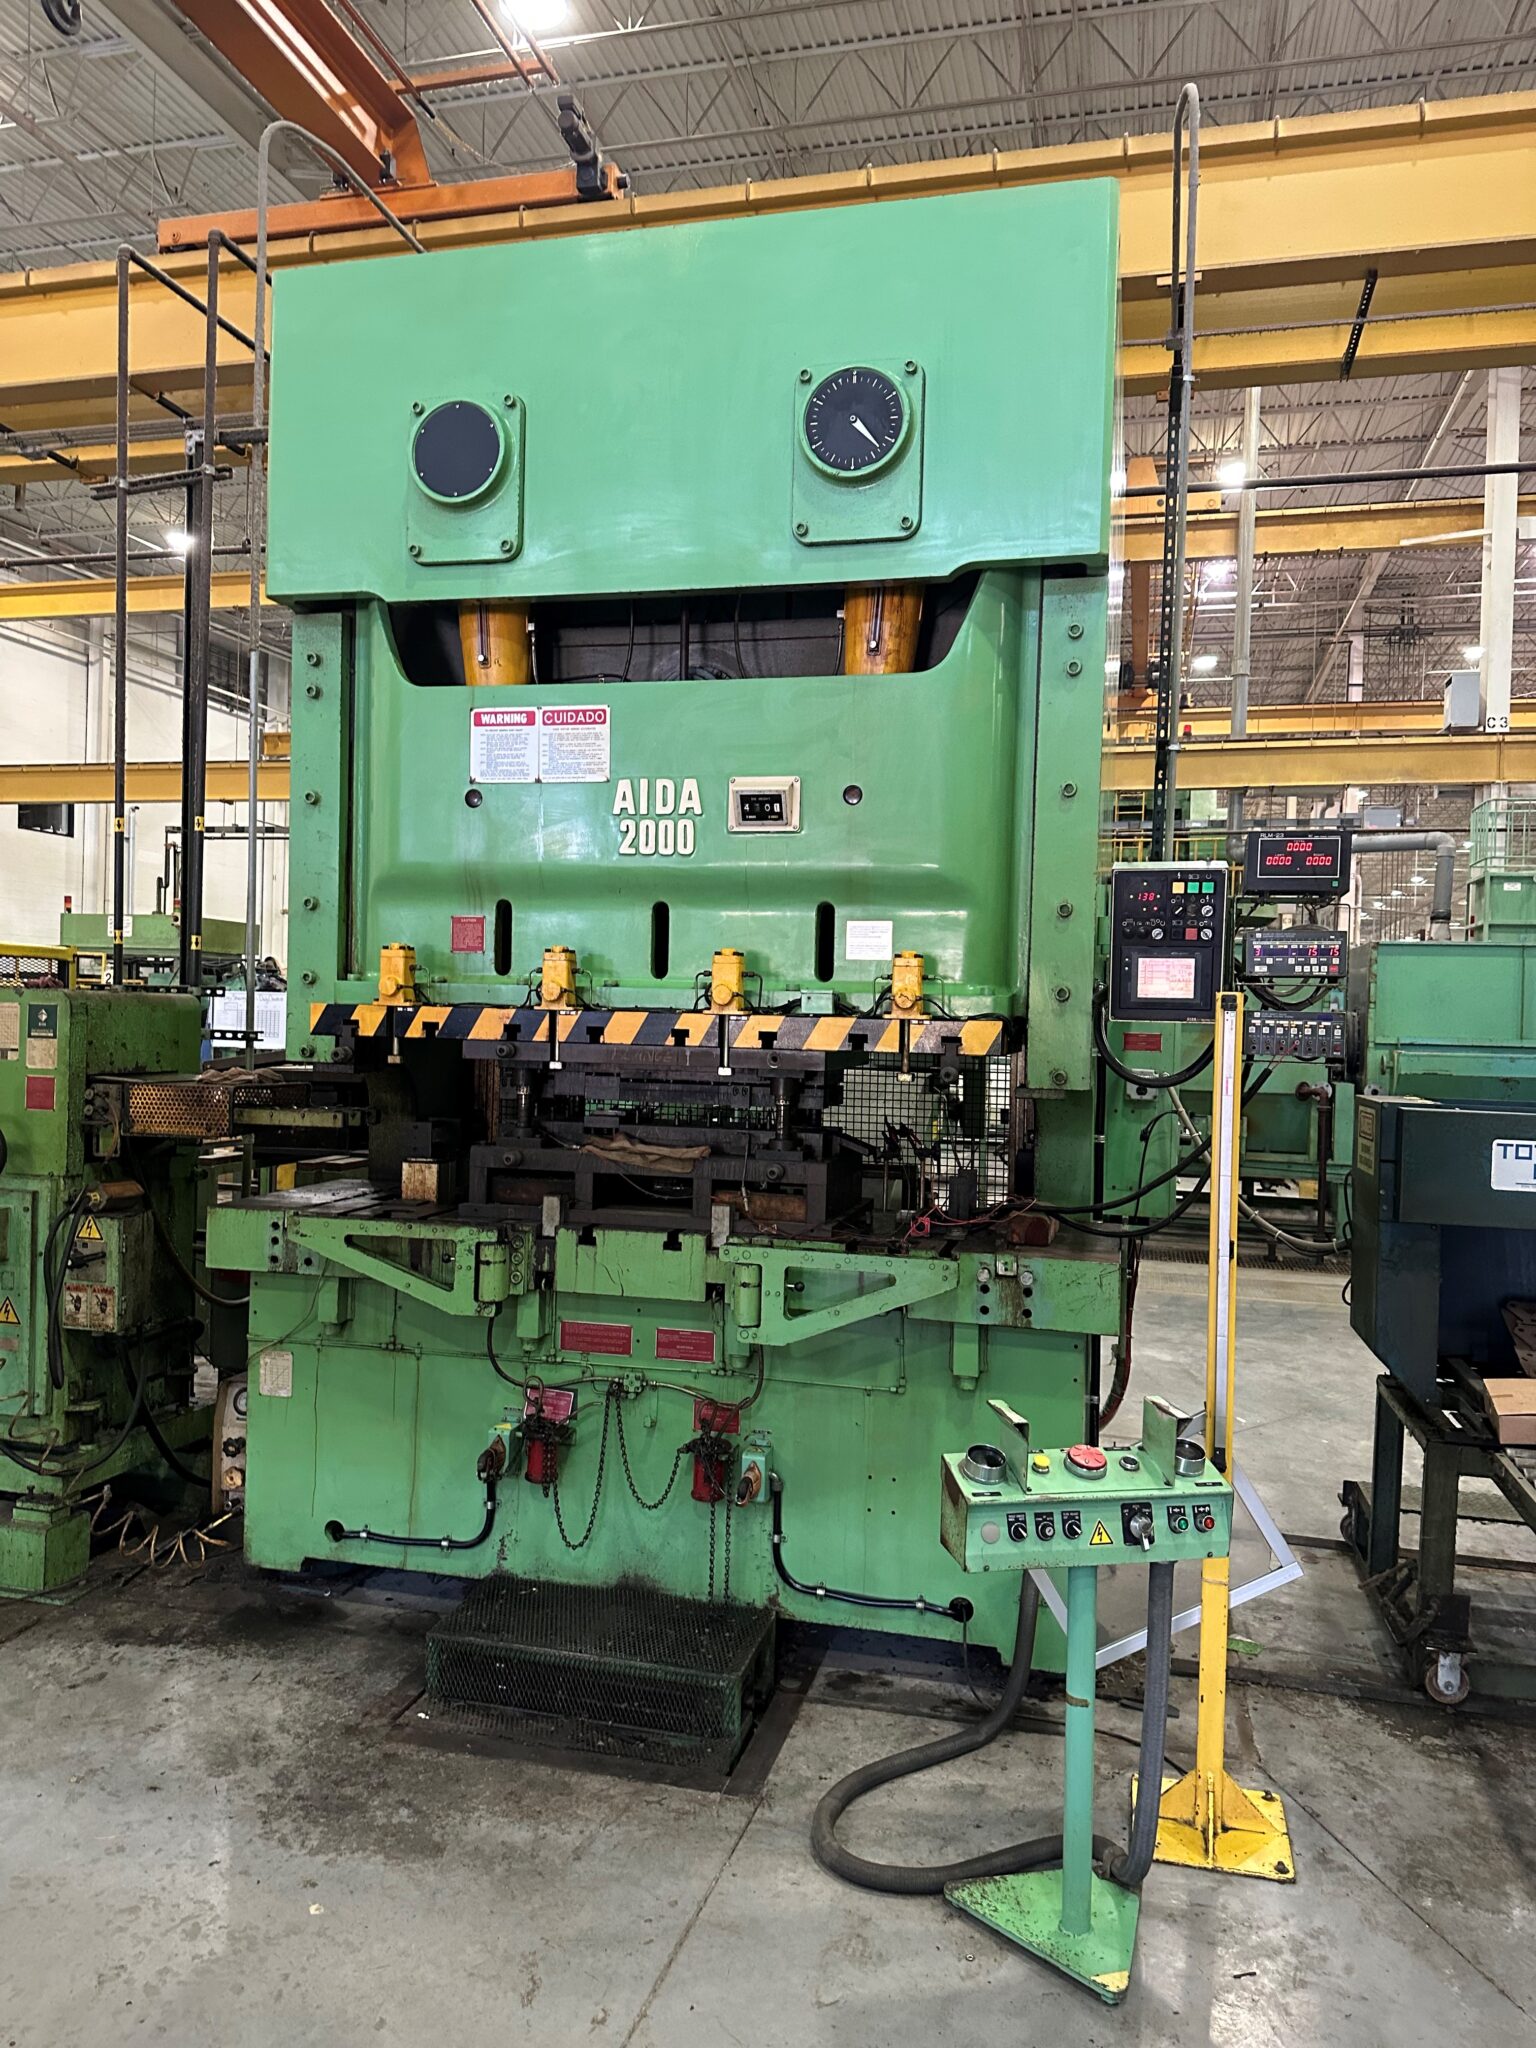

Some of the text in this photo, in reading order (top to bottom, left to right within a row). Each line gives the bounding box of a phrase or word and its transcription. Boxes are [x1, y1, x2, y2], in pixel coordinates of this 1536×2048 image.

[480, 713, 527, 724] WARNING
[544, 711, 604, 723] CUIDADO
[612, 778, 702, 815] AIDA
[618, 818, 695, 856] 2000
[1286, 842, 1313, 851] 0000
[1266, 856, 1292, 865] 0000
[1305, 856, 1332, 865] 0000
[1138, 892, 1155, 901] 138
[1308, 948, 1318, 956] 15
[1330, 948, 1339, 956] 15
[105, 972, 112, 985] 2
[1496, 1143, 1536, 1160] TO
